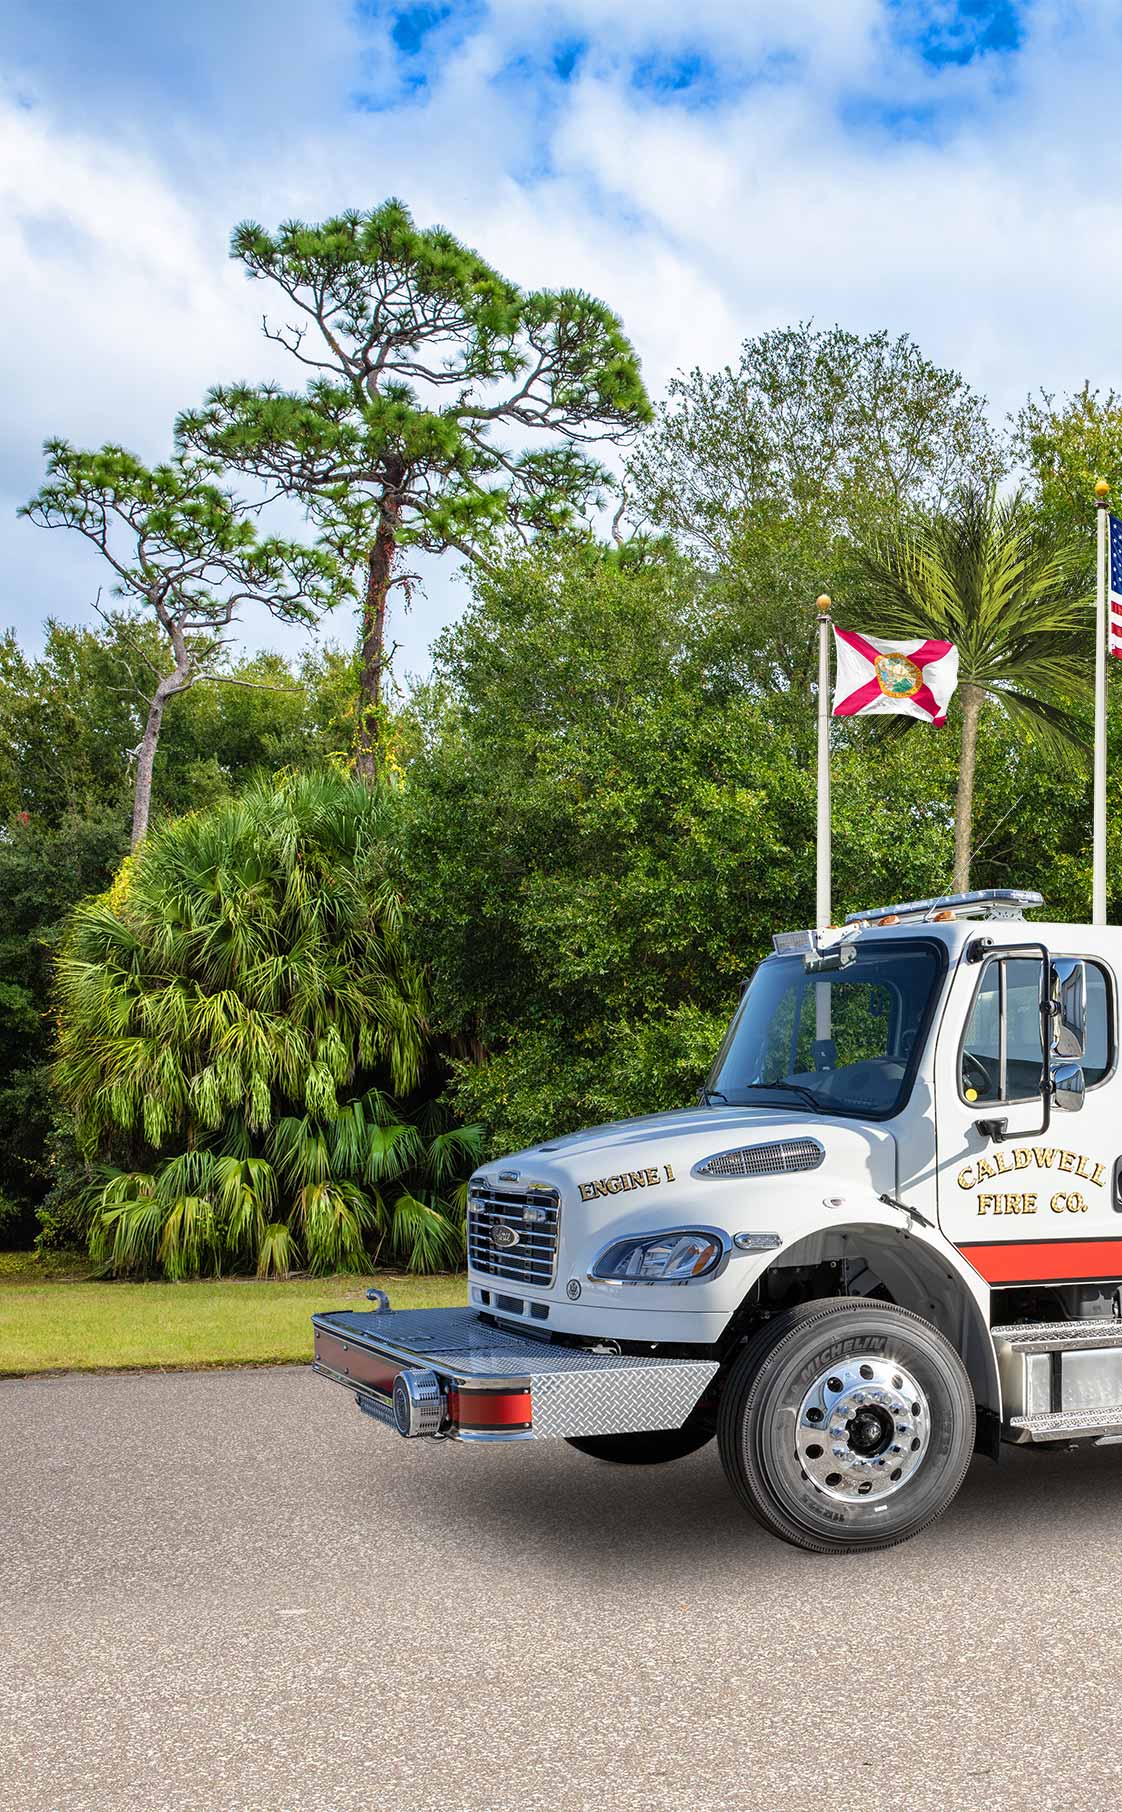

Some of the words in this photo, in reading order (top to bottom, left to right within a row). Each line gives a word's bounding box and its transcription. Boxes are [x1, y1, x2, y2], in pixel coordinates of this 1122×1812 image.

[578, 1167, 661, 1202] ENGINE
[663, 1164, 676, 1183] 1
[957, 1147, 1107, 1190] CALDWELL
[977, 1192, 1038, 1215] FIRE
[1050, 1191, 1089, 1214] CO.
[801, 1336, 887, 1383] MICHELIN
